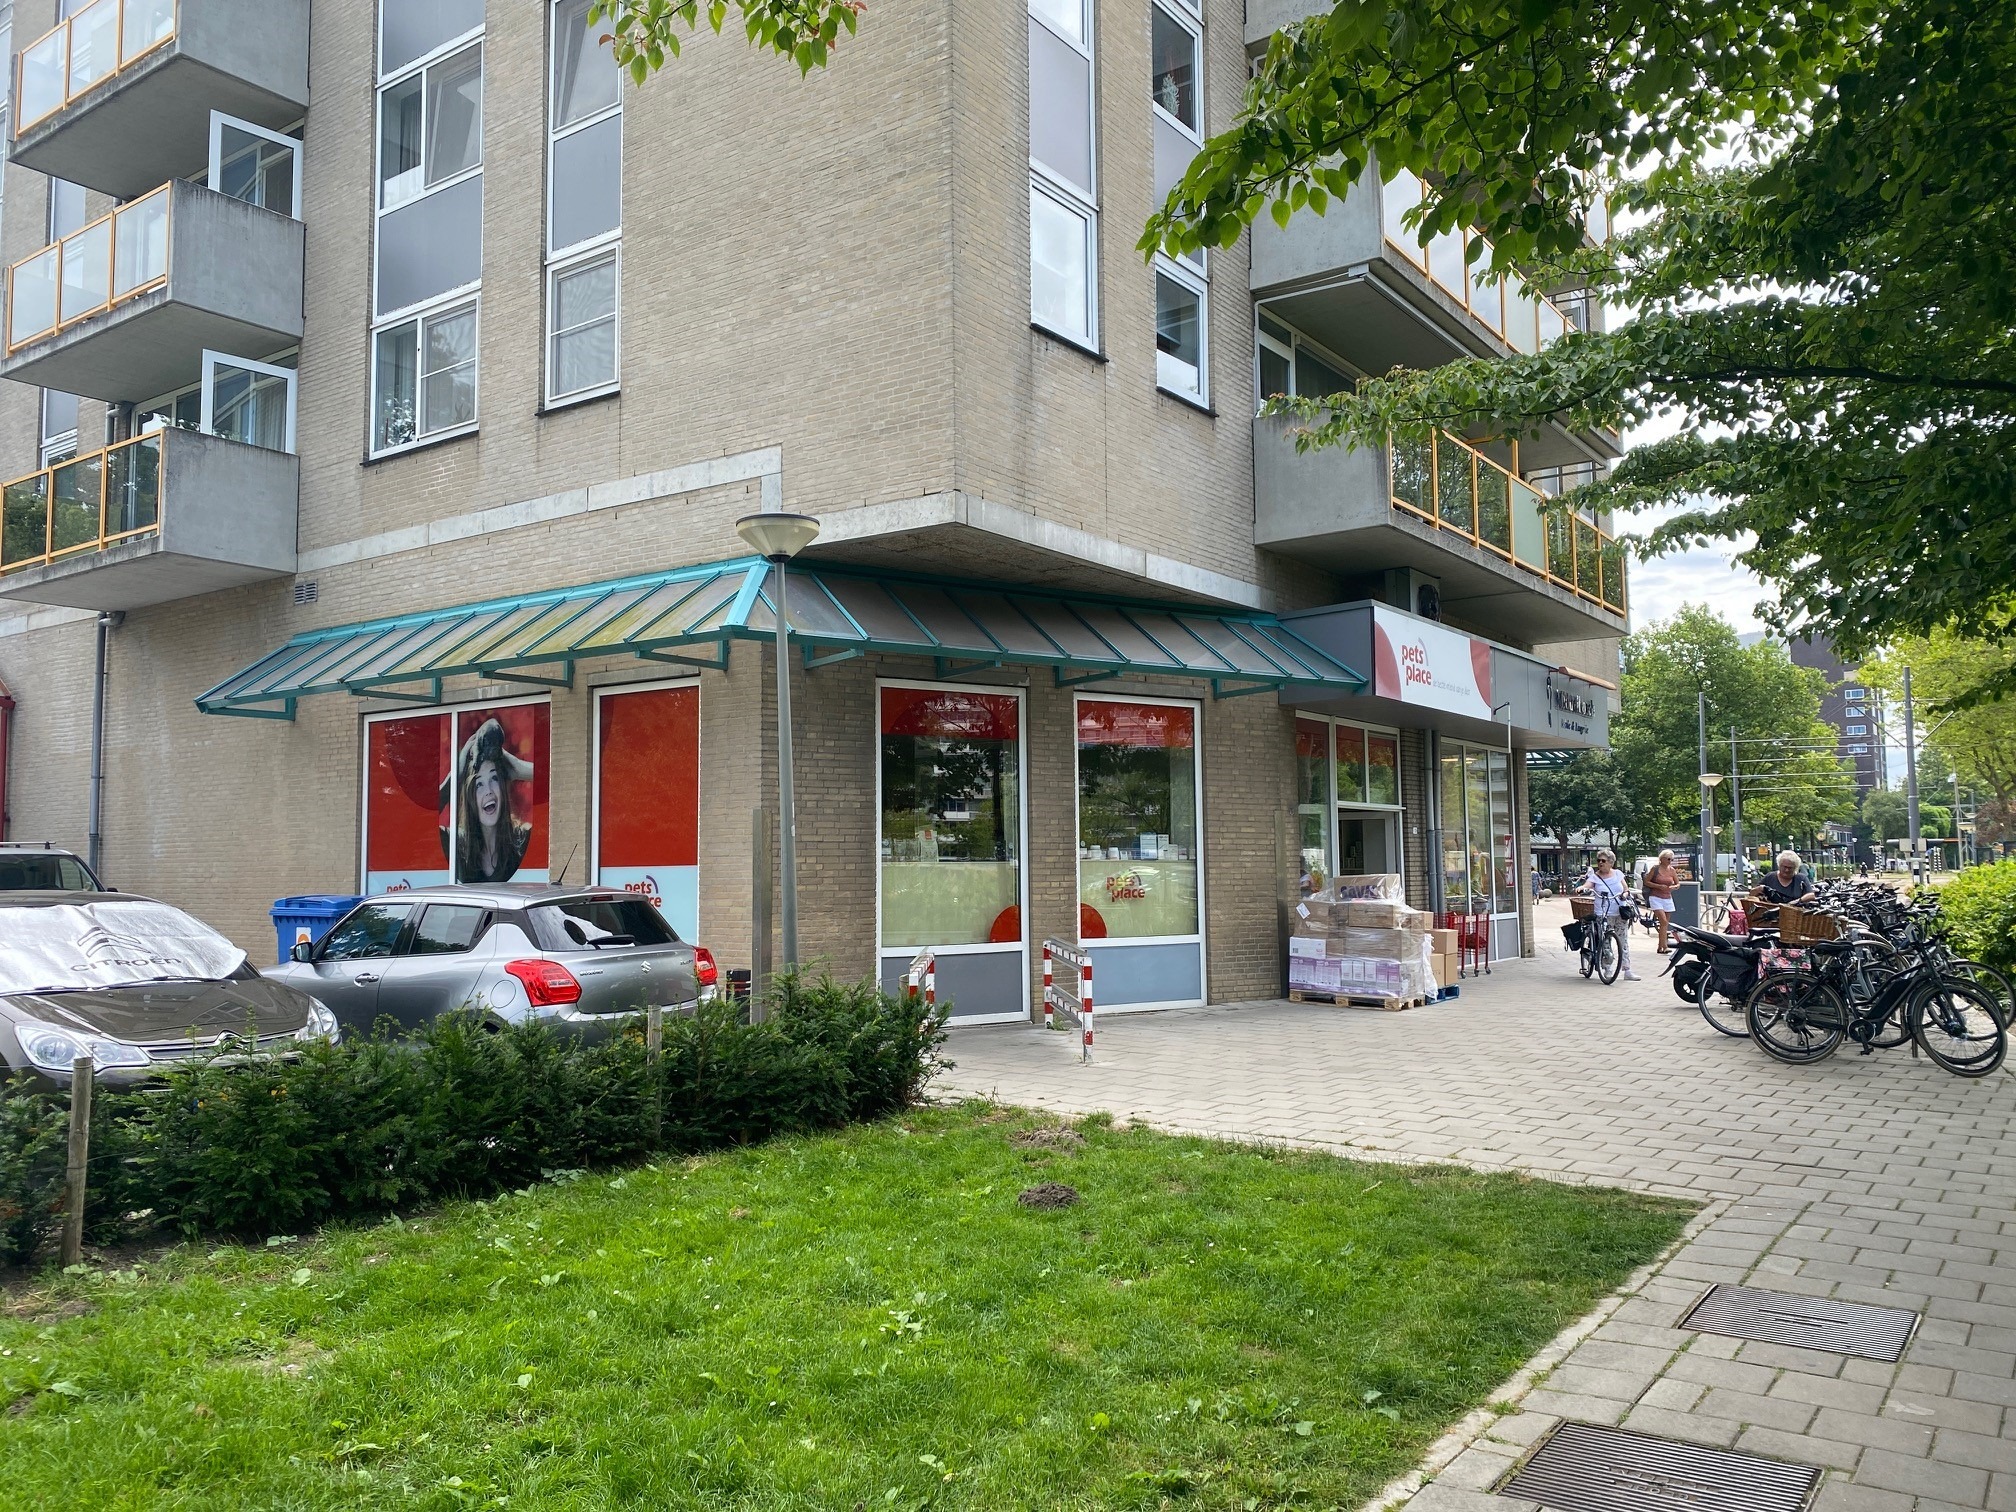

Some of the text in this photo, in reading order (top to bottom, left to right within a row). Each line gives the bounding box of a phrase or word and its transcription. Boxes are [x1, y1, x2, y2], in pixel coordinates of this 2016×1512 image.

[1402, 644, 1424, 665] pets
[1406, 664, 1432, 686] place
[1111, 887, 1146, 902] place
